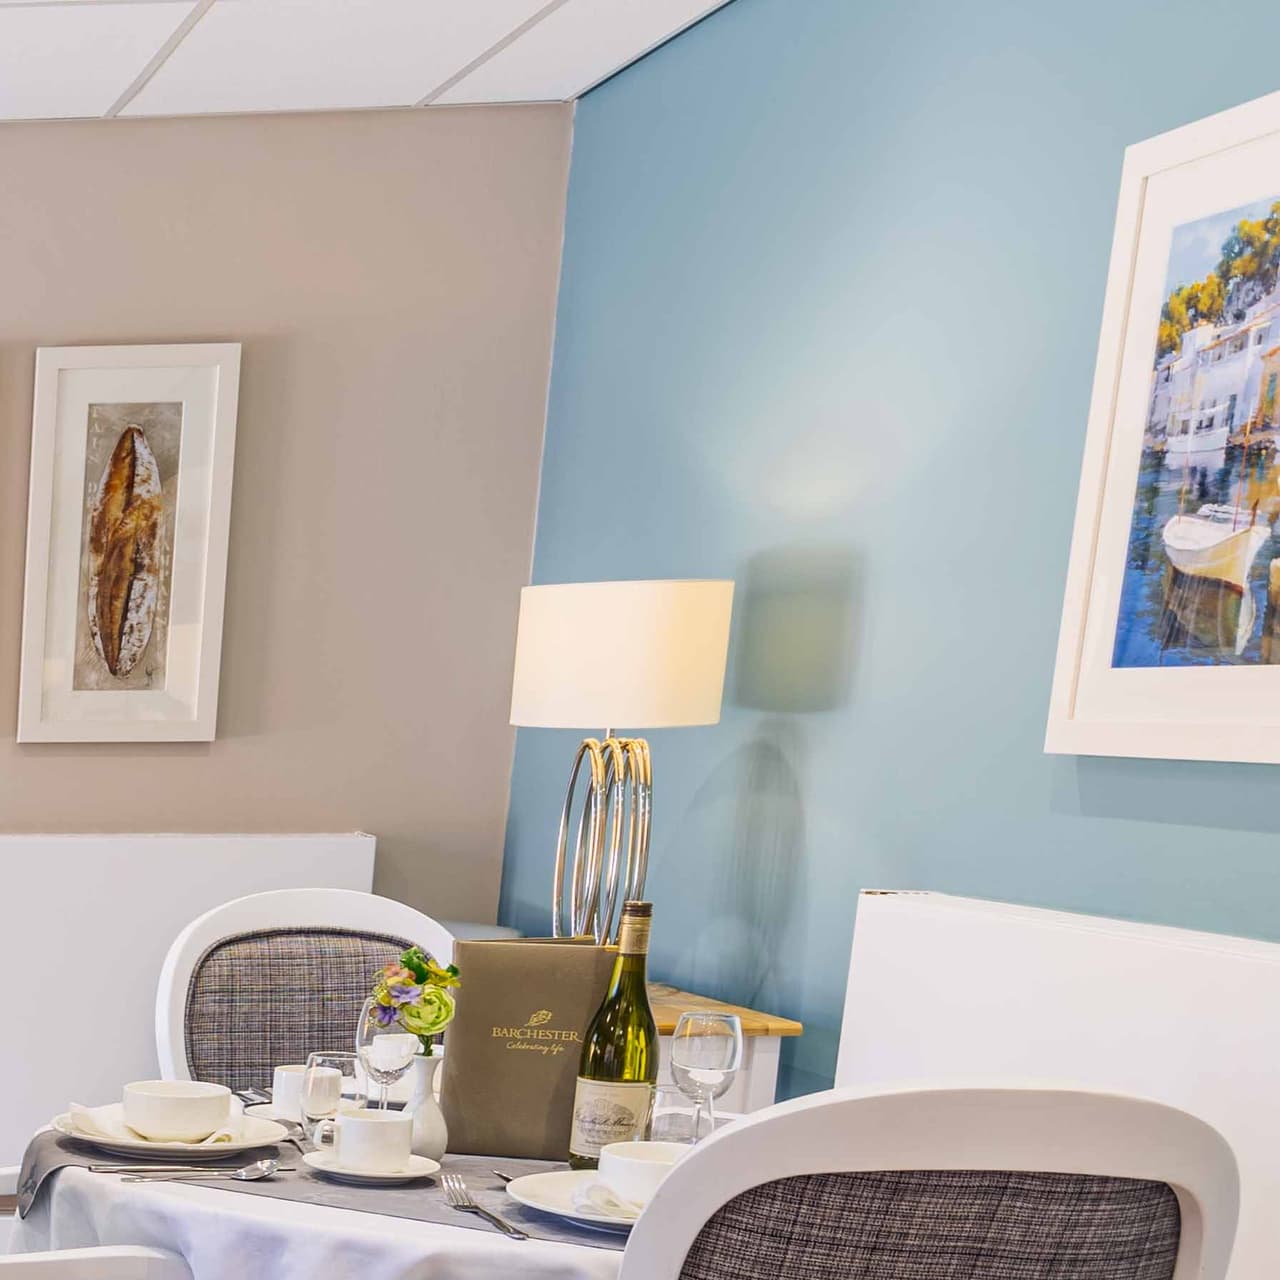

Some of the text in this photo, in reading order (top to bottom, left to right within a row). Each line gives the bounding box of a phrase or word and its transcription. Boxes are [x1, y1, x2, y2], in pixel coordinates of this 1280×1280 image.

[492, 1026, 583, 1043] BARCHESTER
[506, 1041, 565, 1055] Celebrating life
